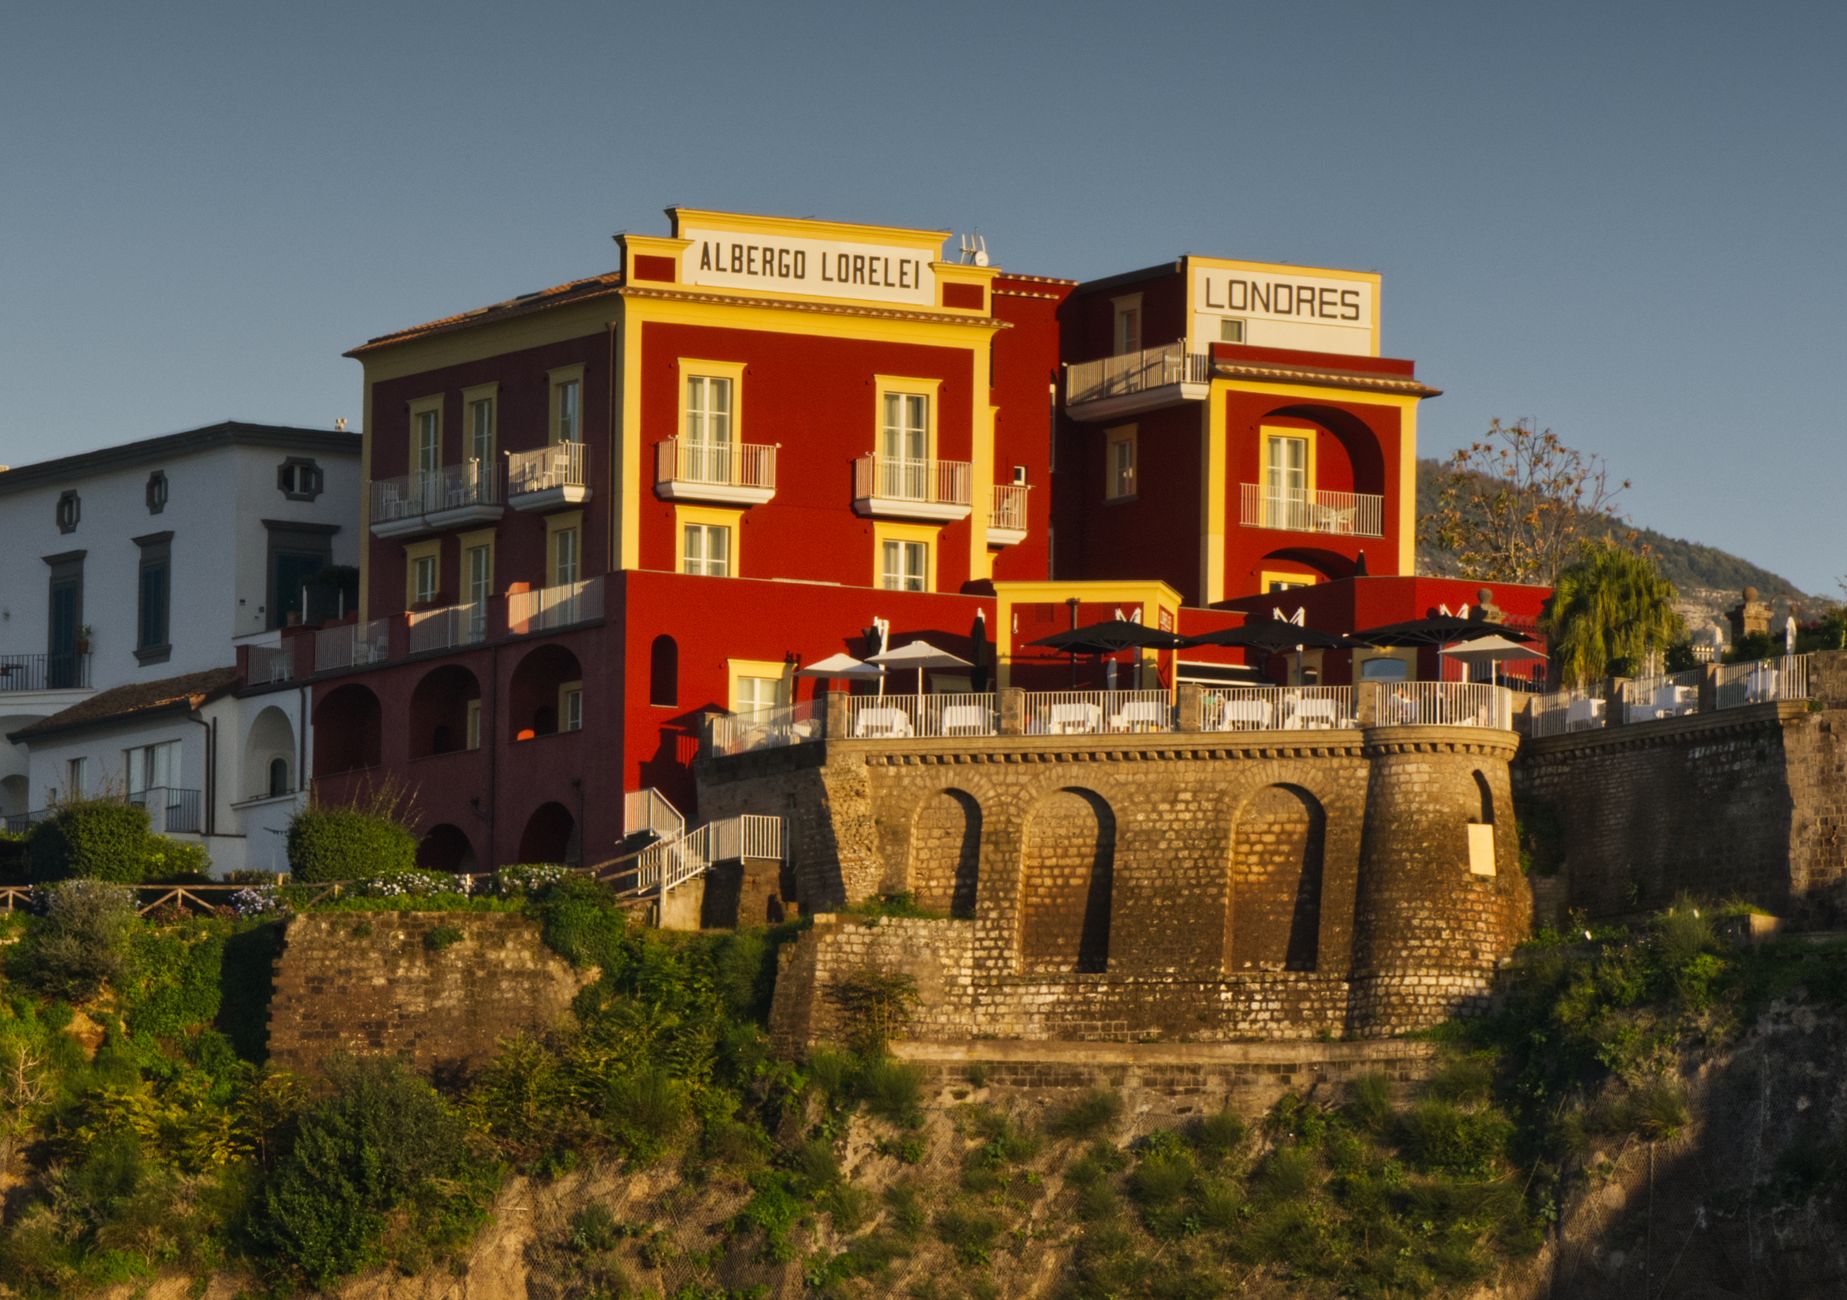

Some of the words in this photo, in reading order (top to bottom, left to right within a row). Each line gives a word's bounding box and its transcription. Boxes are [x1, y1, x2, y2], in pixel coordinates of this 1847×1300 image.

[700, 241, 806, 280] ALBERGO
[821, 252, 919, 290] LORELEI
[1206, 277, 1360, 321] LONDRES
